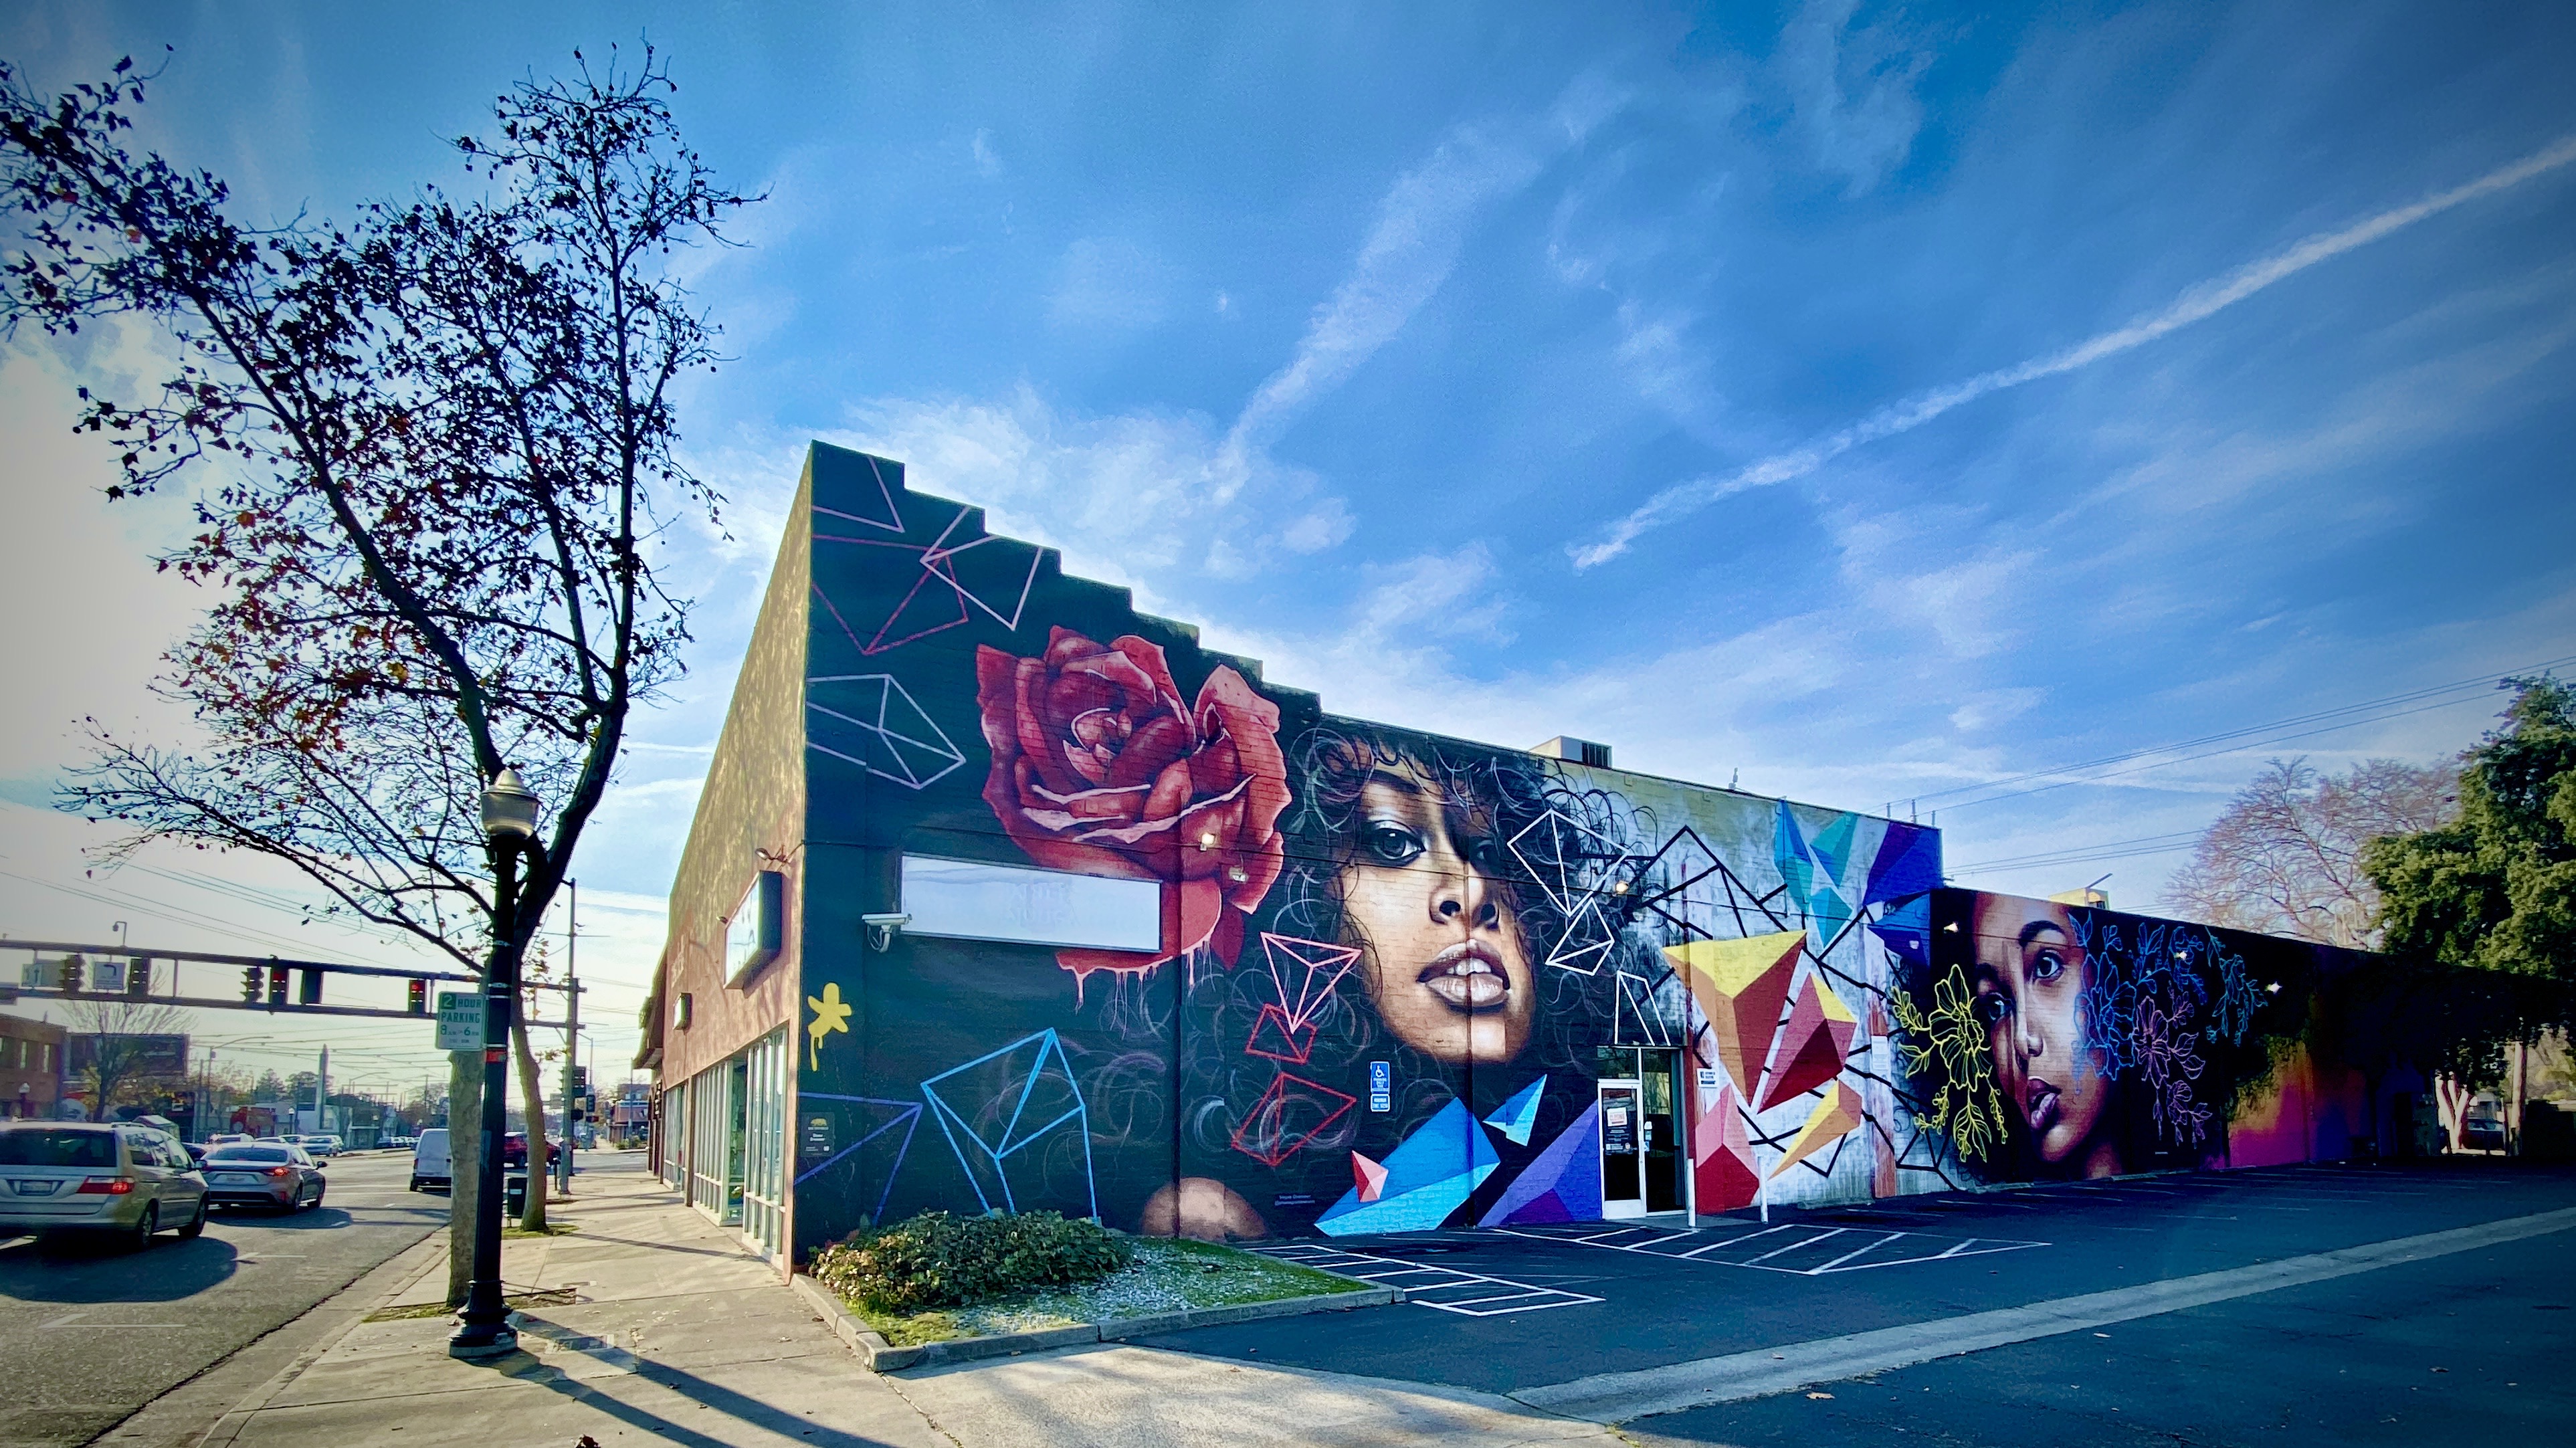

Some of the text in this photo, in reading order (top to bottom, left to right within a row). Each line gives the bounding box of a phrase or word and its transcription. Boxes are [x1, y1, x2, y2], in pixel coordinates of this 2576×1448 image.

[443, 995, 482, 1008] 2 HOUR
[441, 1012, 480, 1023] PARKING
[441, 1025, 447, 1035] 8
[464, 1027, 471, 1036] 6
